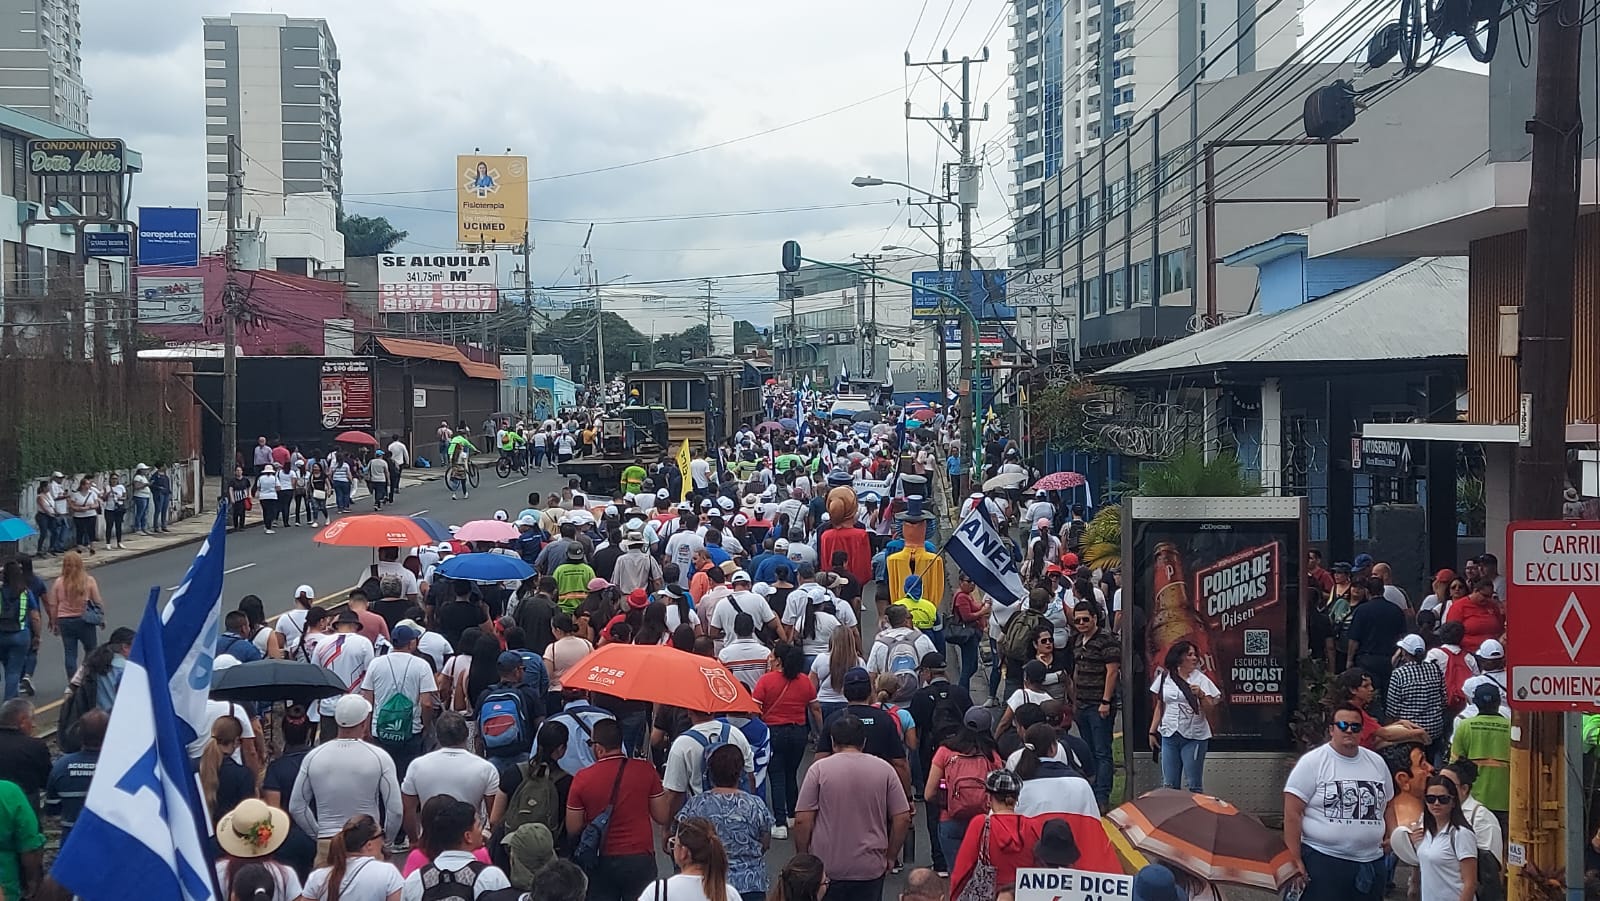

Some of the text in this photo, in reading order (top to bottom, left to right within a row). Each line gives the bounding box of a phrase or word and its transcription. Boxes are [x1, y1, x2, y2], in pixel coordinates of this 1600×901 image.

[34, 141, 117, 150] CONDOMINIOS
[31, 150, 121, 172] Doña Lolita
[463, 222, 506, 231] UCIMED
[140, 230, 197, 240] aeropost.com
[382, 256, 491, 268] SE ALQUILA
[1203, 561, 1250, 598] PODER
[1252, 551, 1271, 578] DE
[1207, 575, 1267, 617] COMPAS
[1221, 607, 1255, 631] Pilsen
[1234, 658, 1279, 667] ESCUCHA EL
[590, 665, 626, 678] APSE
[1231, 667, 1284, 681] PODCAST
[1019, 873, 1134, 897] ANDE DICE
